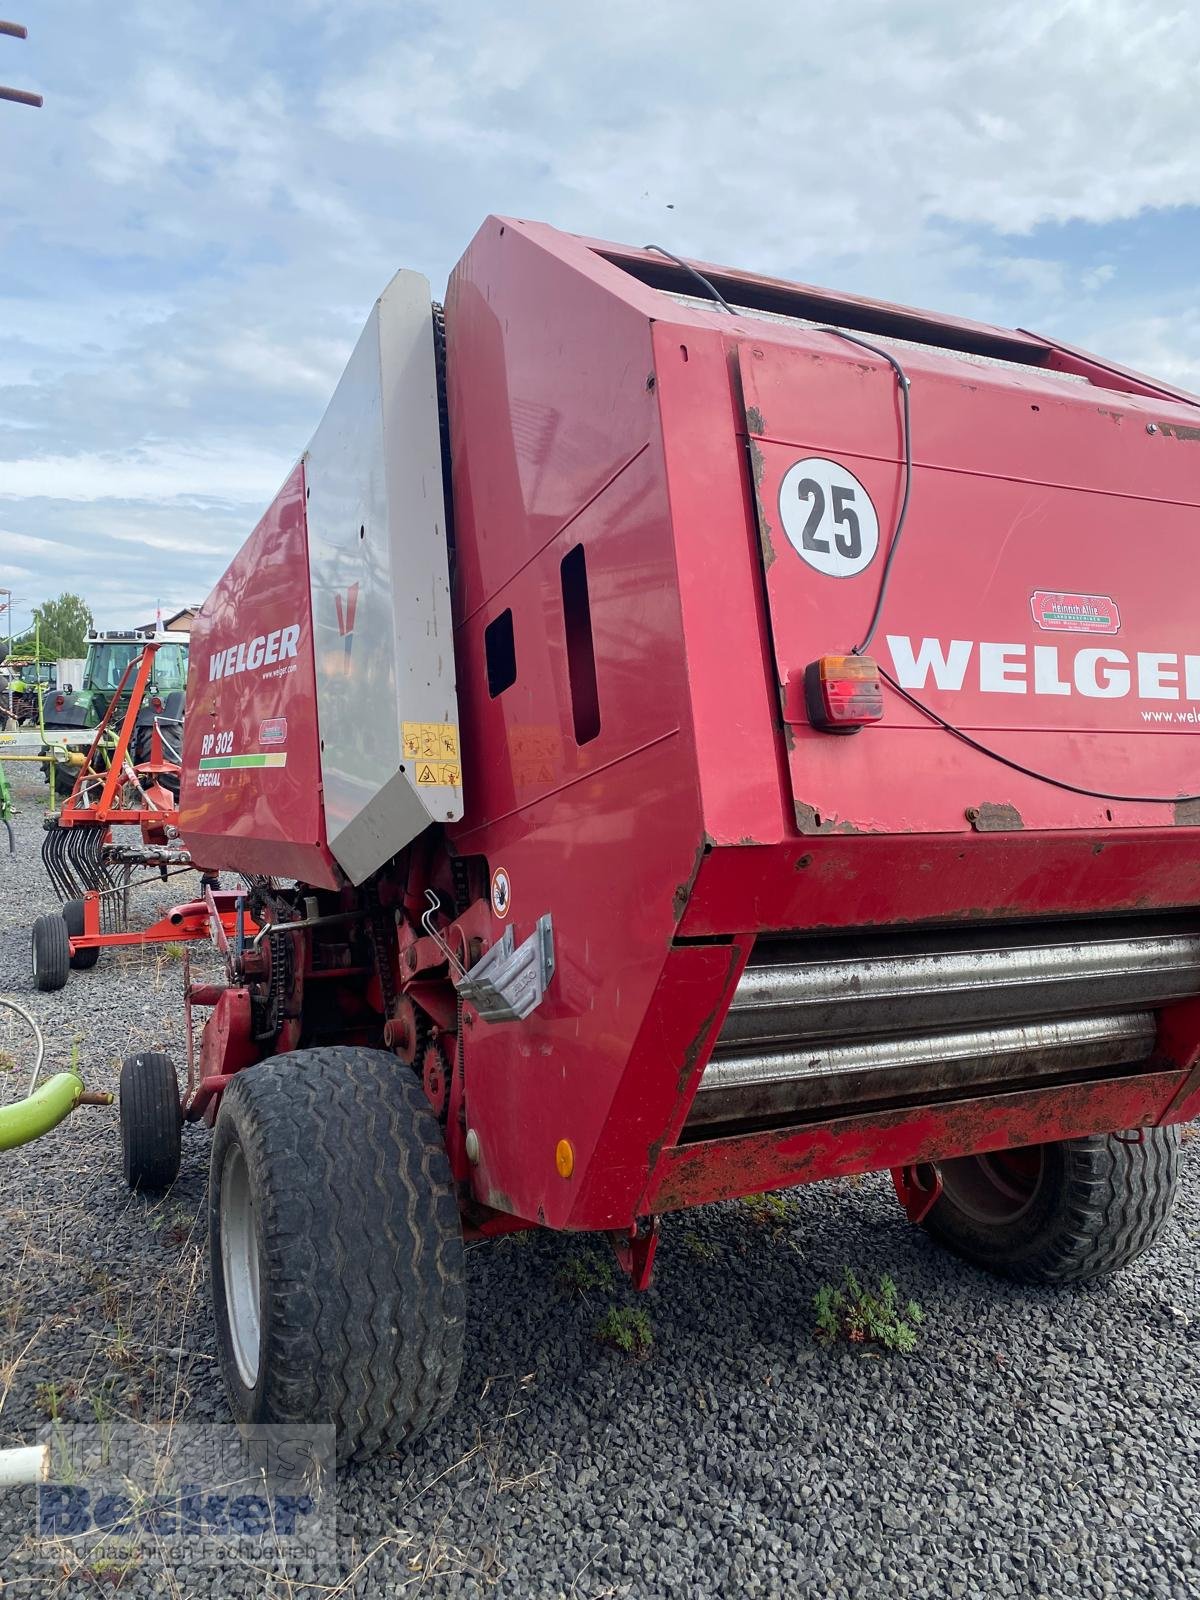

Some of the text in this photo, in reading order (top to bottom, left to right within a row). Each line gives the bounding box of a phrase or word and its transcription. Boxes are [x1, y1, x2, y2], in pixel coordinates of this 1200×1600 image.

[797, 477, 863, 560] 25
[208, 623, 301, 682] WELGER
[262, 664, 298, 680] www.welger.com
[201, 730, 234, 756] RP 302
[196, 772, 221, 787] SPECIAL
